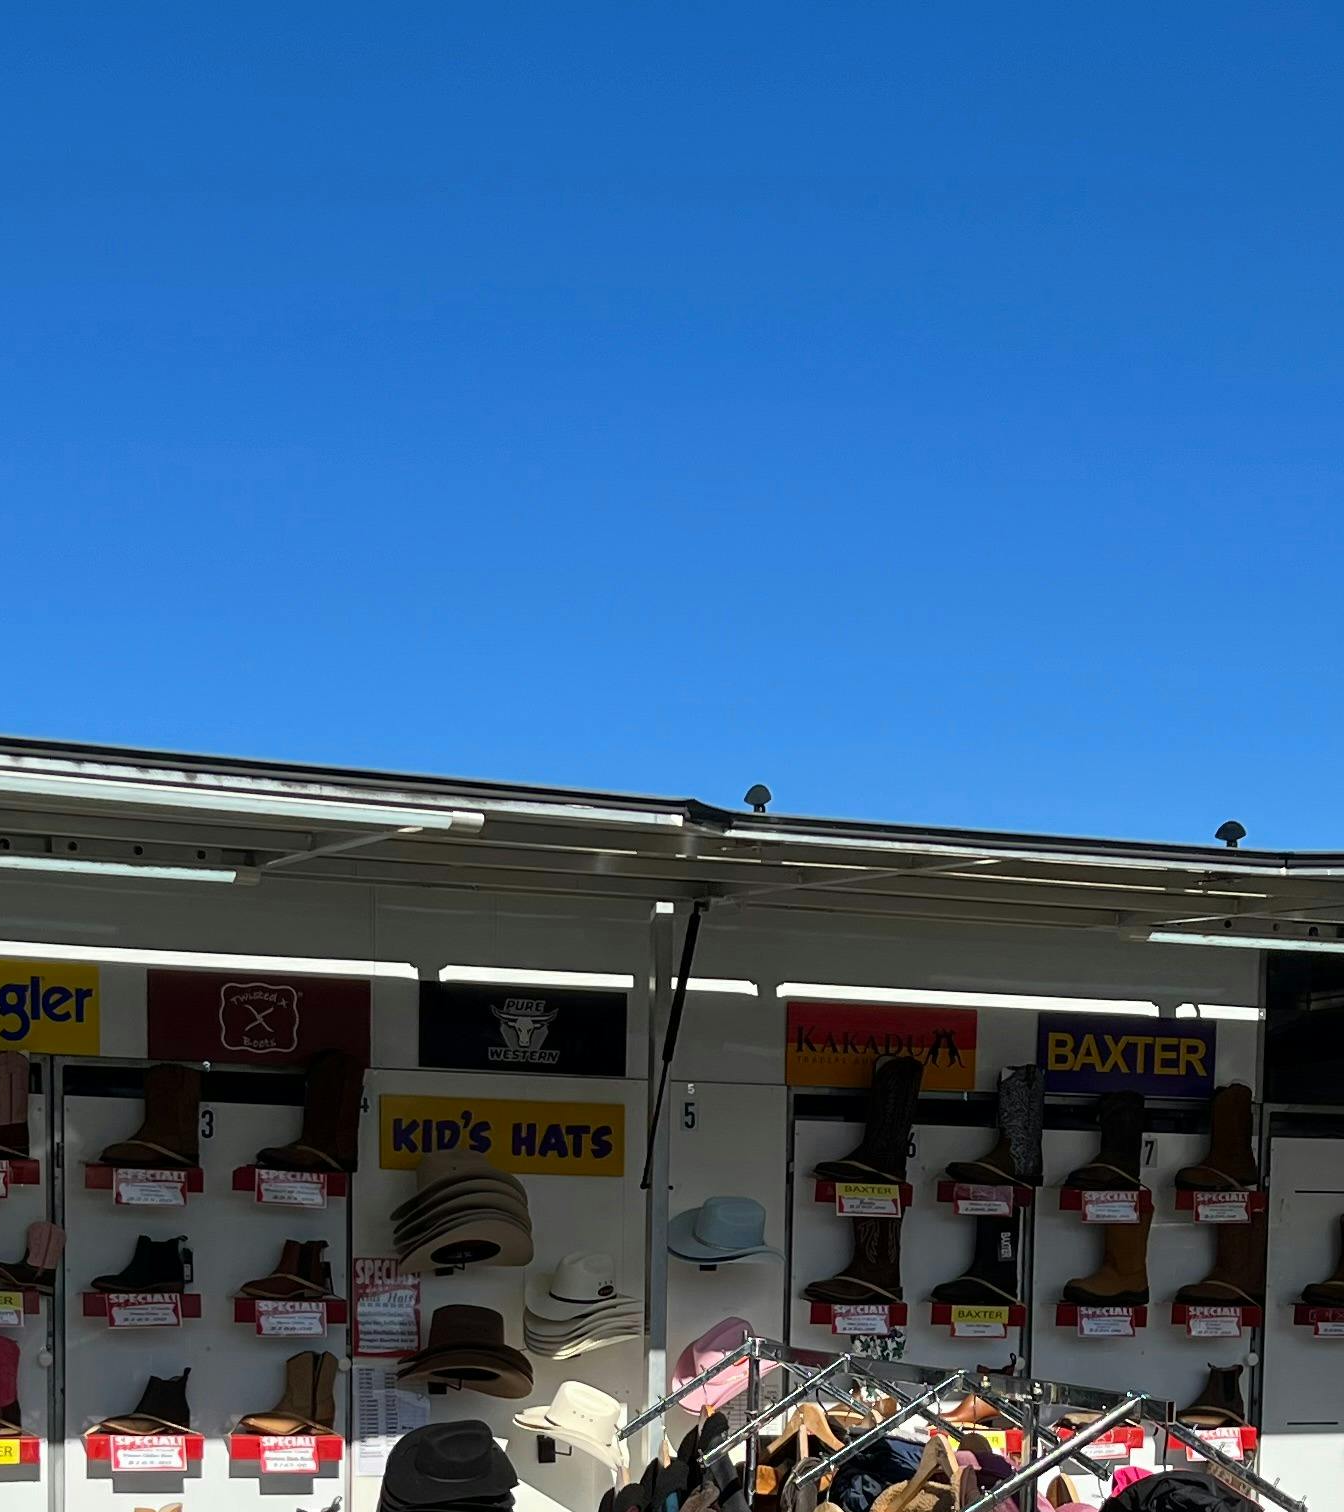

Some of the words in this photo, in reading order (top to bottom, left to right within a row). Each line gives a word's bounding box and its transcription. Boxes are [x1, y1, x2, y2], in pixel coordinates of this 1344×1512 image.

[506, 999, 545, 1013] PURE
[488, 1047, 560, 1064] WESTERN
[1048, 1031, 1208, 1078] BAXTER
[201, 1110, 214, 1138] 3
[684, 1103, 696, 1128] 5
[392, 1110, 493, 1153] KID'S
[511, 1121, 615, 1159] HATS
[1144, 1141, 1154, 1166] 7
[844, 1185, 892, 1195] BAXTER
[109, 1293, 179, 1304] SPECIAL!
[957, 1309, 1004, 1320] BAXTER
